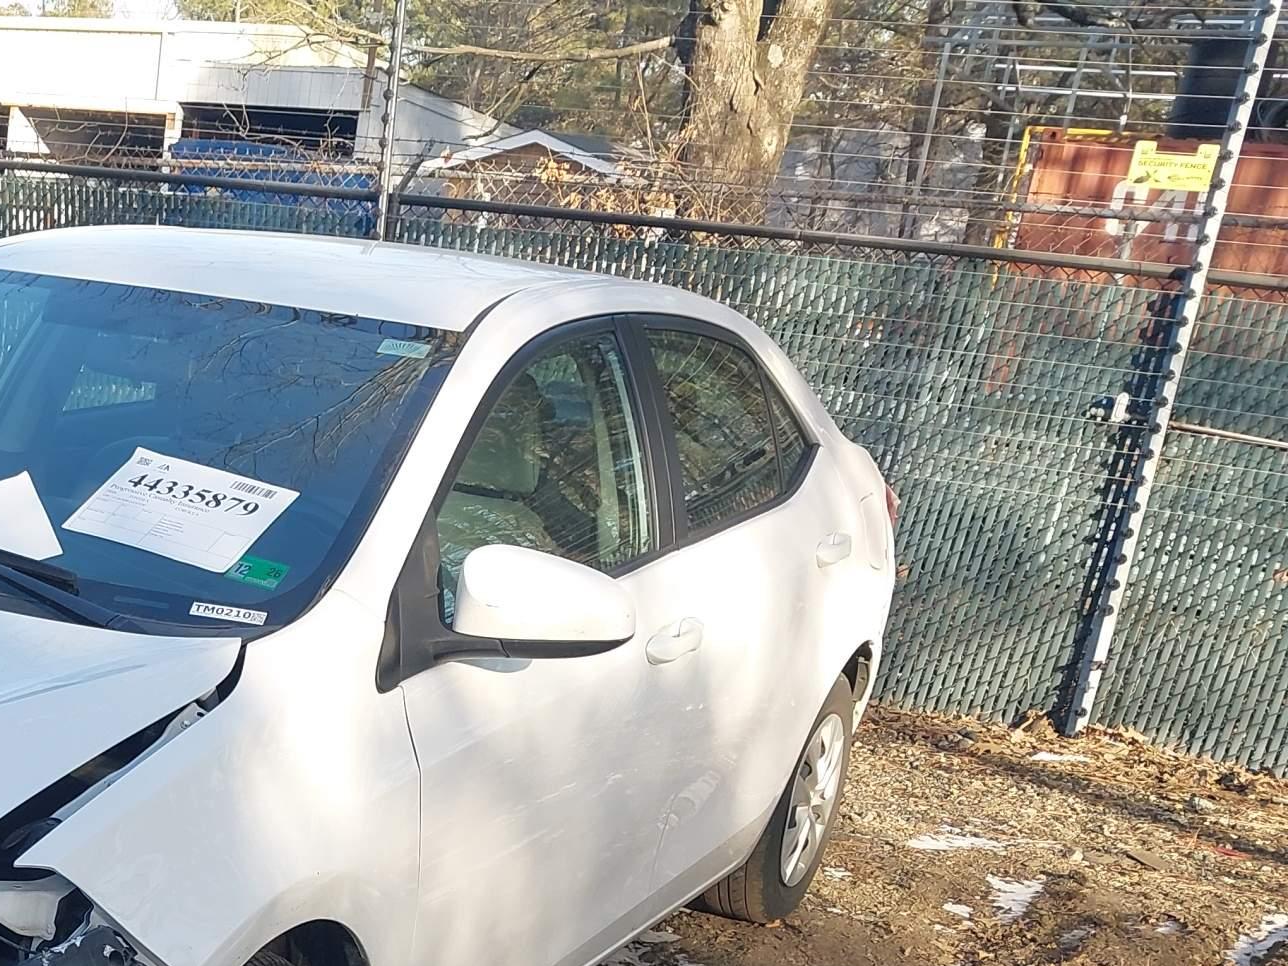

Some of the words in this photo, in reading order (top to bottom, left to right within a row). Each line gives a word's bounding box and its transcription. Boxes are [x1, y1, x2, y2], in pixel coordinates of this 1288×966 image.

[1138, 160, 1178, 169] SECURITY
[1179, 163, 1209, 171] FENCE
[110, 483, 149, 498] Progressive
[148, 492, 178, 506] Casualty
[177, 500, 211, 514] Insurance
[128, 474, 261, 517] 44335879
[234, 561, 252, 577] 12
[266, 567, 281, 578] 26
[193, 603, 252, 620] TM0210
